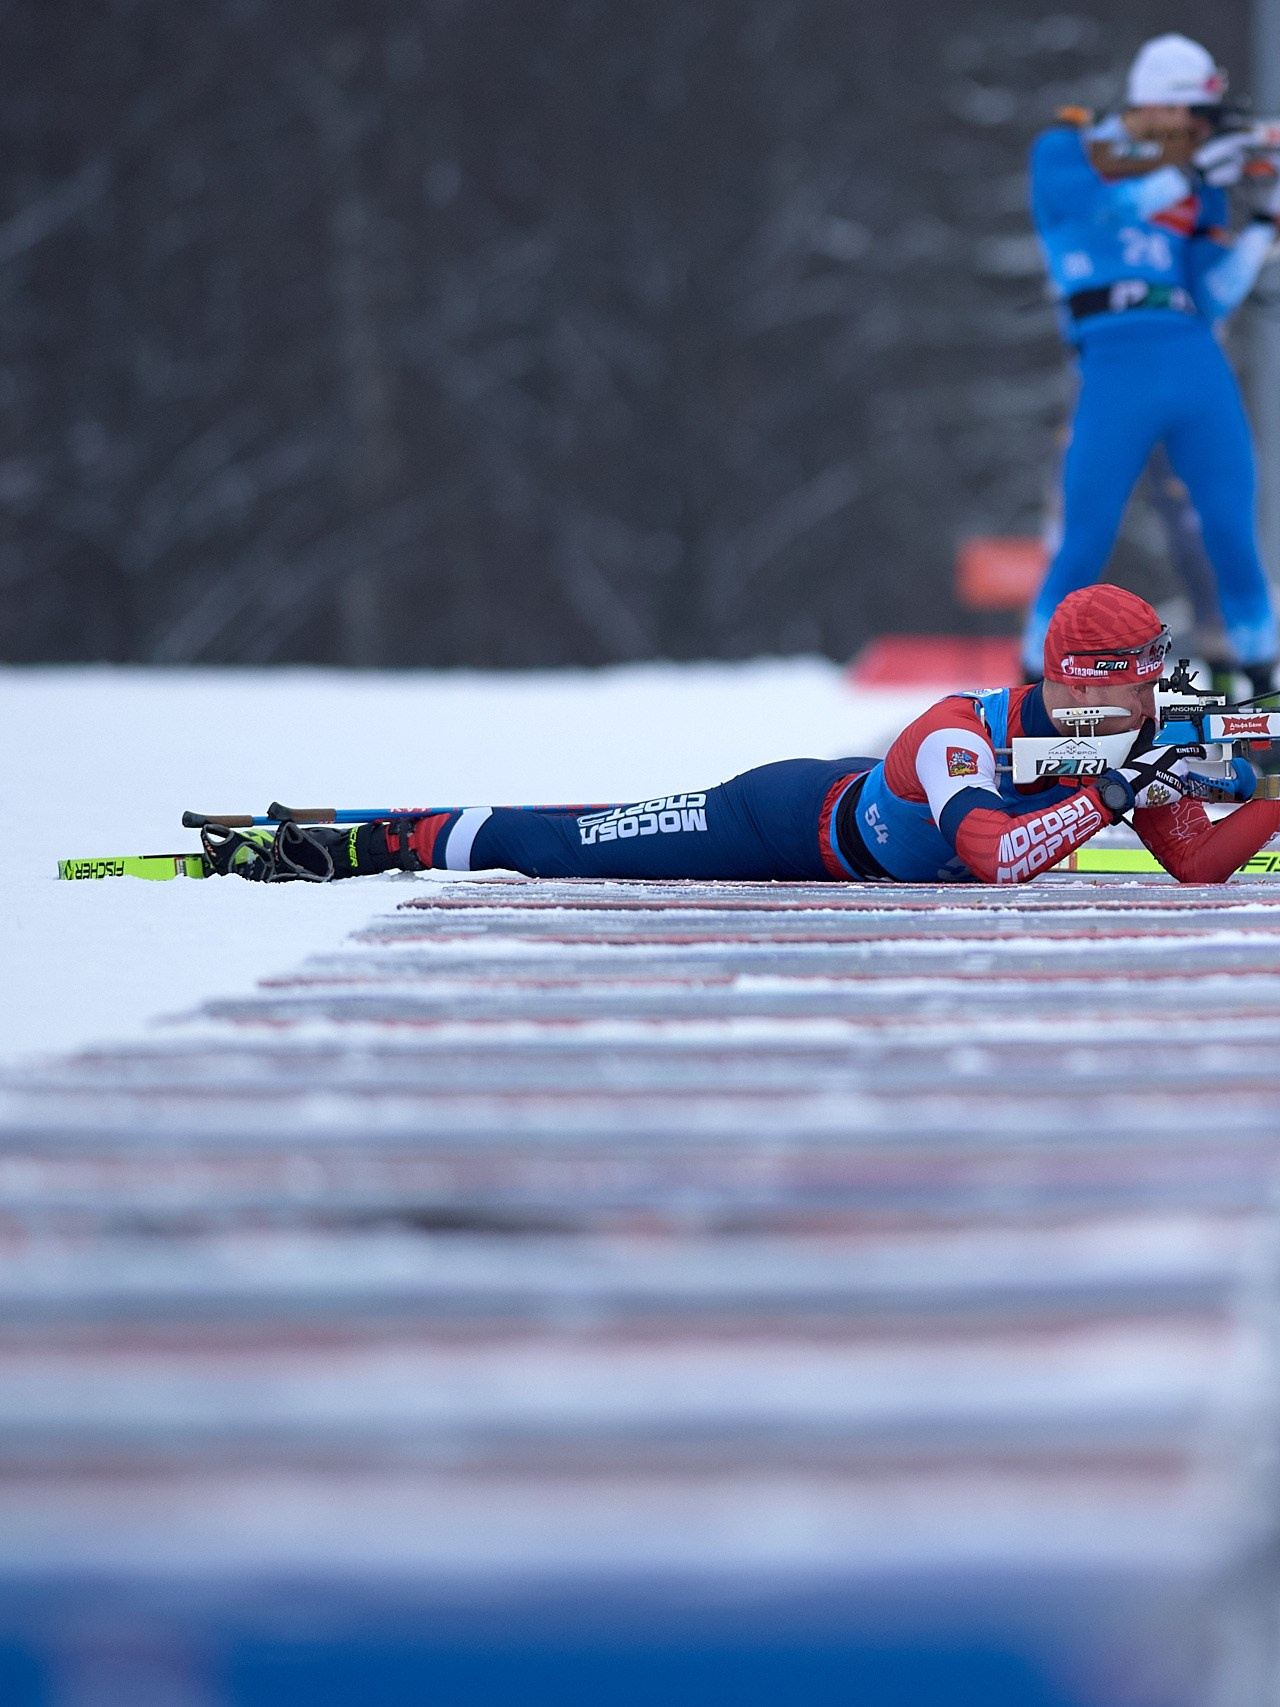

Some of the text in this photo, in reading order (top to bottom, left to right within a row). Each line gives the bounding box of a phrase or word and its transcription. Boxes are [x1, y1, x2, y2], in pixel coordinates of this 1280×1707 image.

[1095, 660, 1129, 670] PARI
[1039, 758, 1106, 775] PARI
[864, 802, 890, 845] 54
[75, 860, 125, 879] FISCHER
